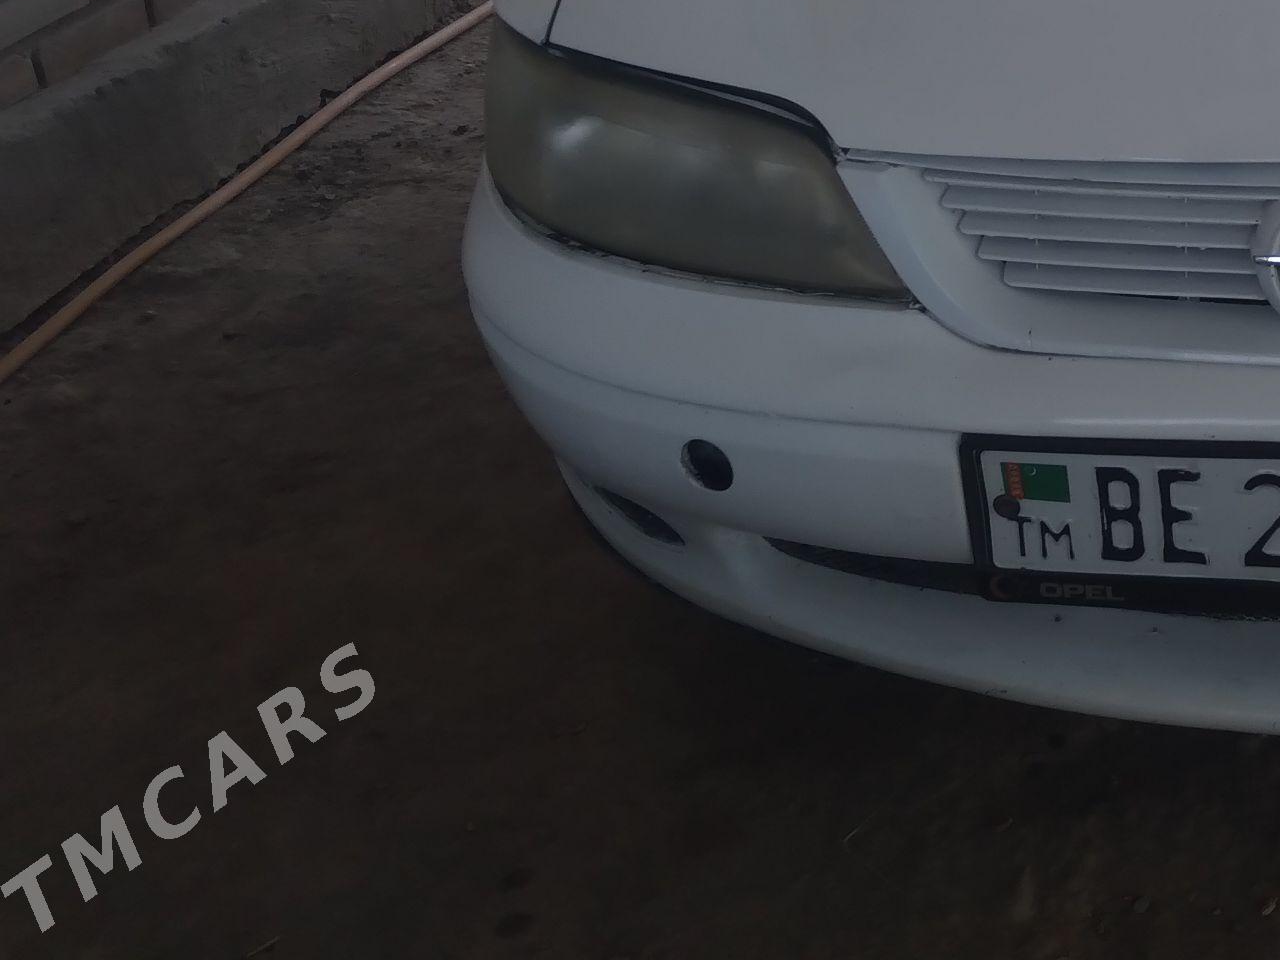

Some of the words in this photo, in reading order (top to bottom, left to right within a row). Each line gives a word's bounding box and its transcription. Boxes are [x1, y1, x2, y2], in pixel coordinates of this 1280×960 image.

[1008, 515, 1075, 560] TM
[1095, 466, 1208, 565] BE
[1040, 583, 1126, 601] OPEL
